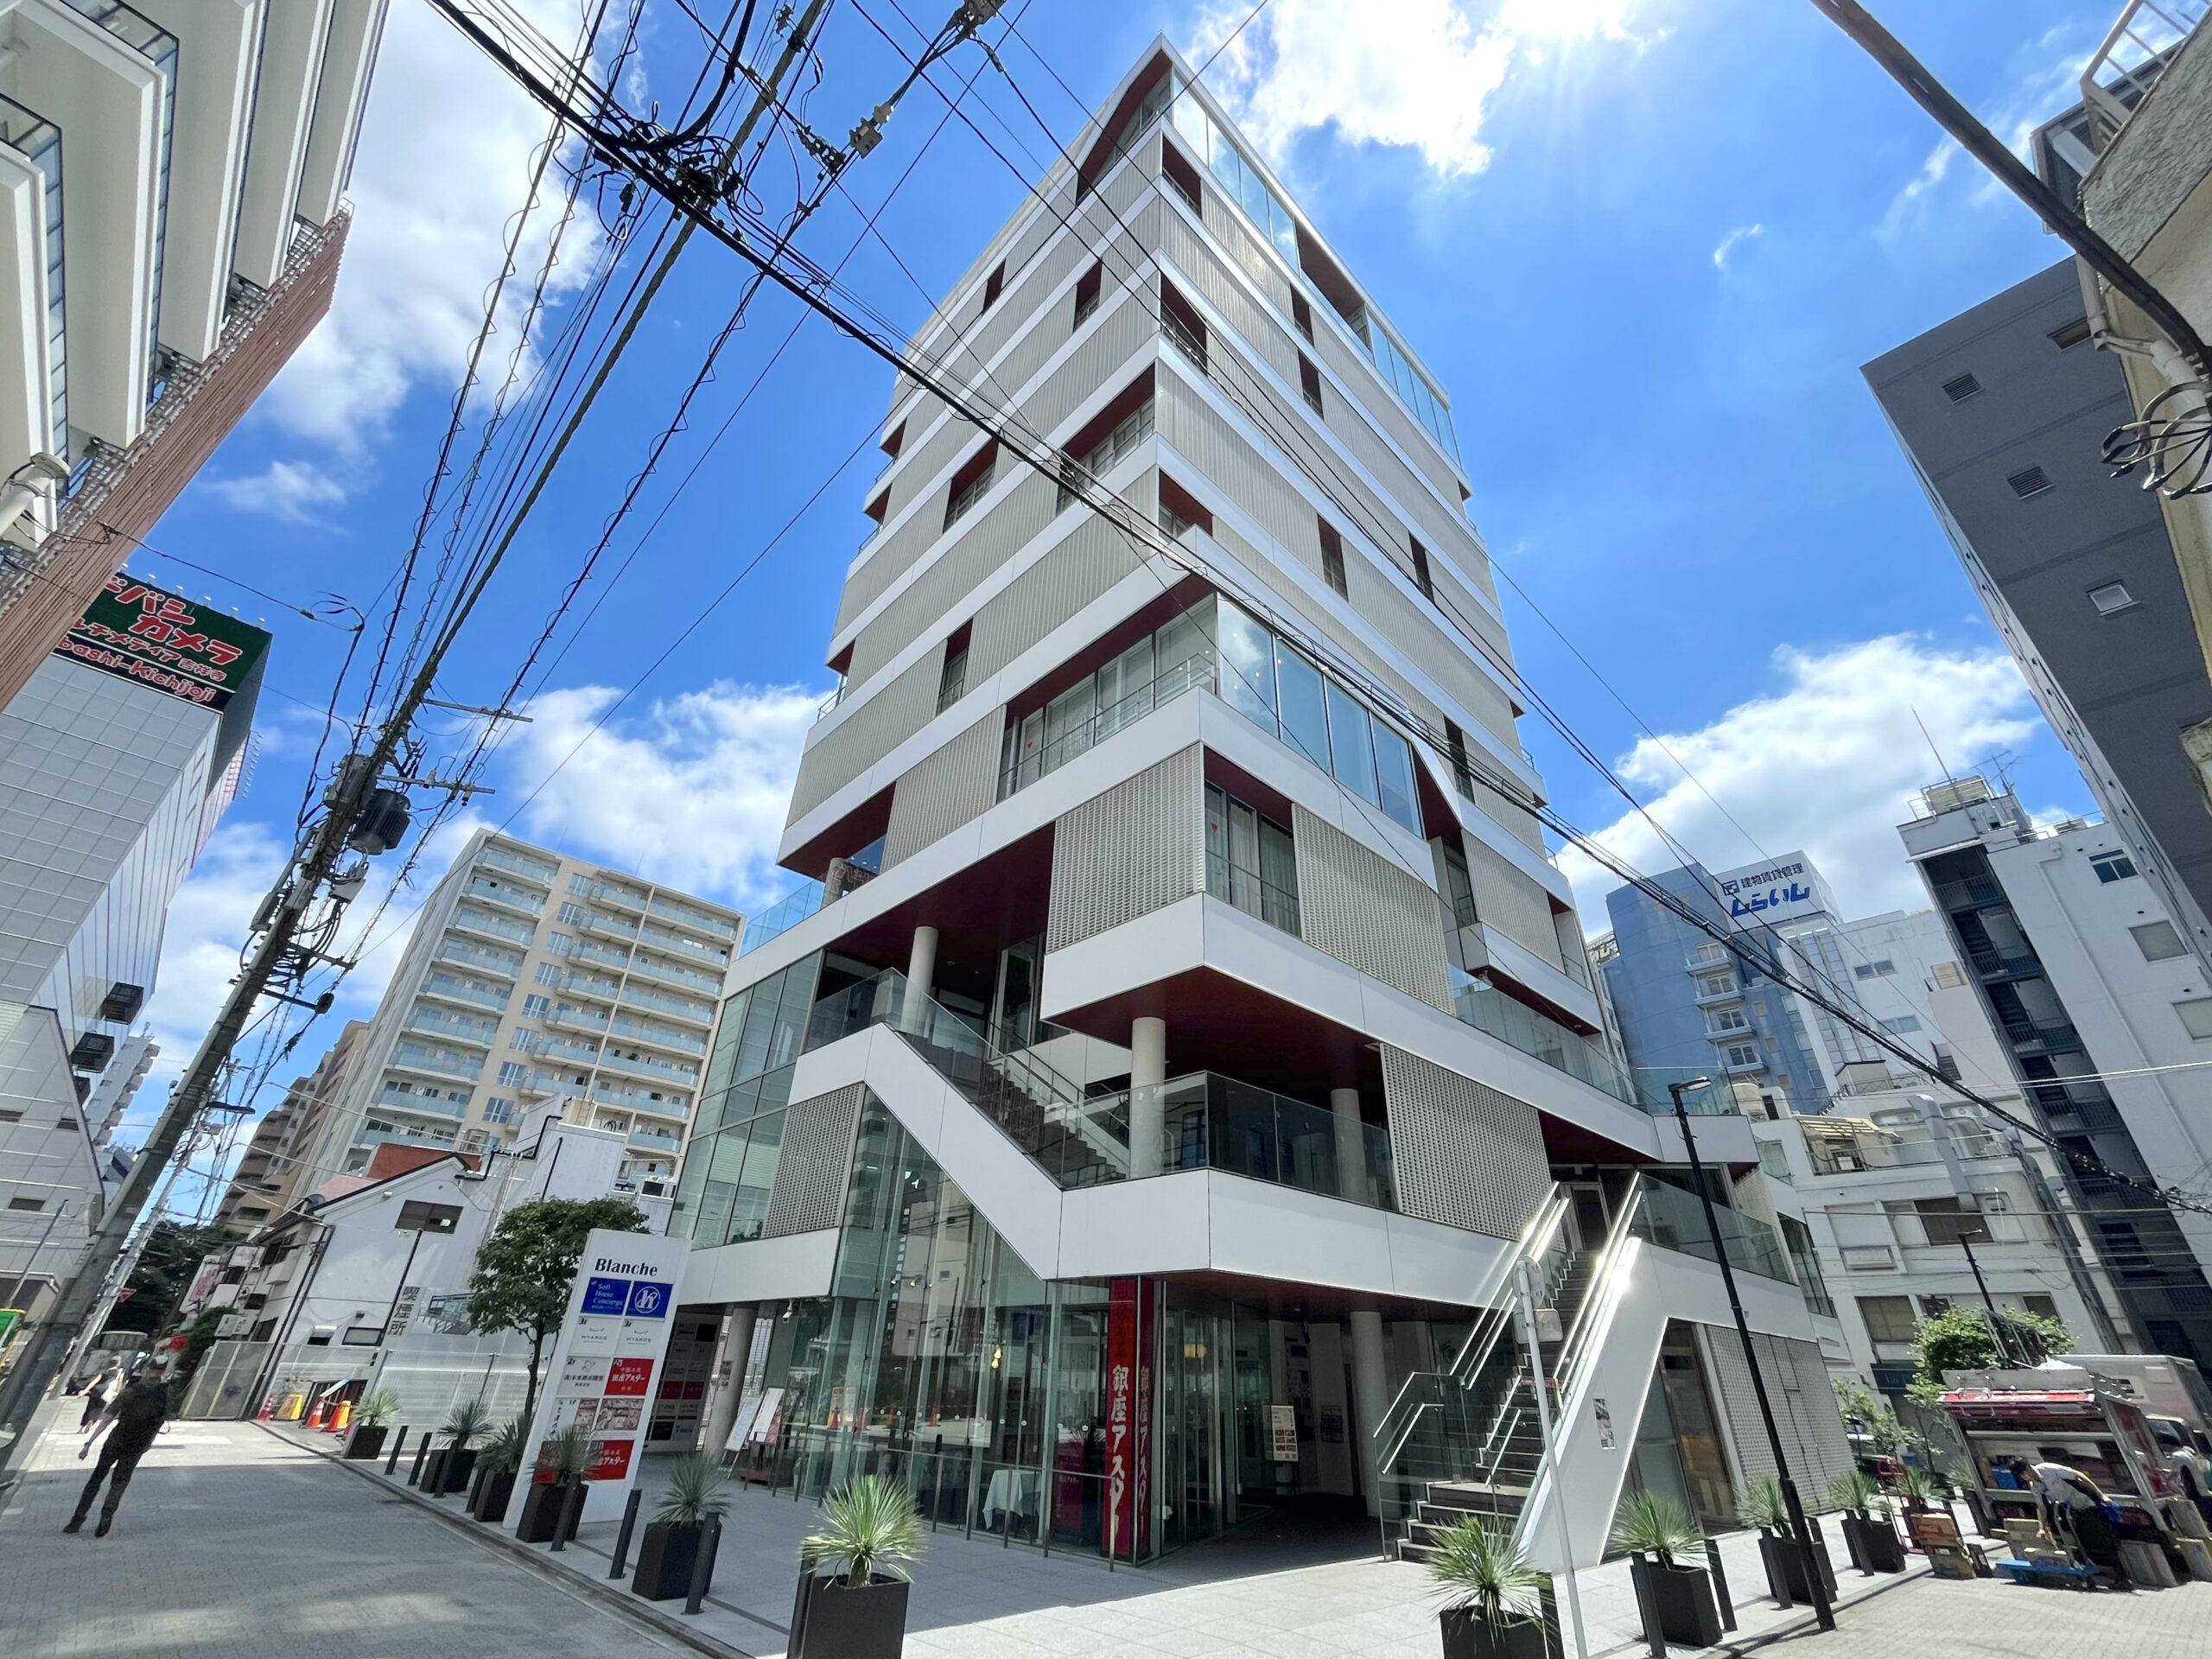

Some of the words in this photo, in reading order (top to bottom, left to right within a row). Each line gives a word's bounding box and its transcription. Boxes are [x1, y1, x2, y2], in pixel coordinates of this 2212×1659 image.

[128, 613, 243, 665] カメラ
[1740, 862, 1805, 888] 建物賃貸管理
[1731, 883, 1811, 918] しらいし
[594, 1258, 658, 1277] Blanche
[387, 1286, 421, 1336] 喫煙所
[611, 1373, 646, 1382] 銀座アスター
[597, 1456, 626, 1466] 座アスター
[1109, 1363, 1128, 1539] 銀座アスター
